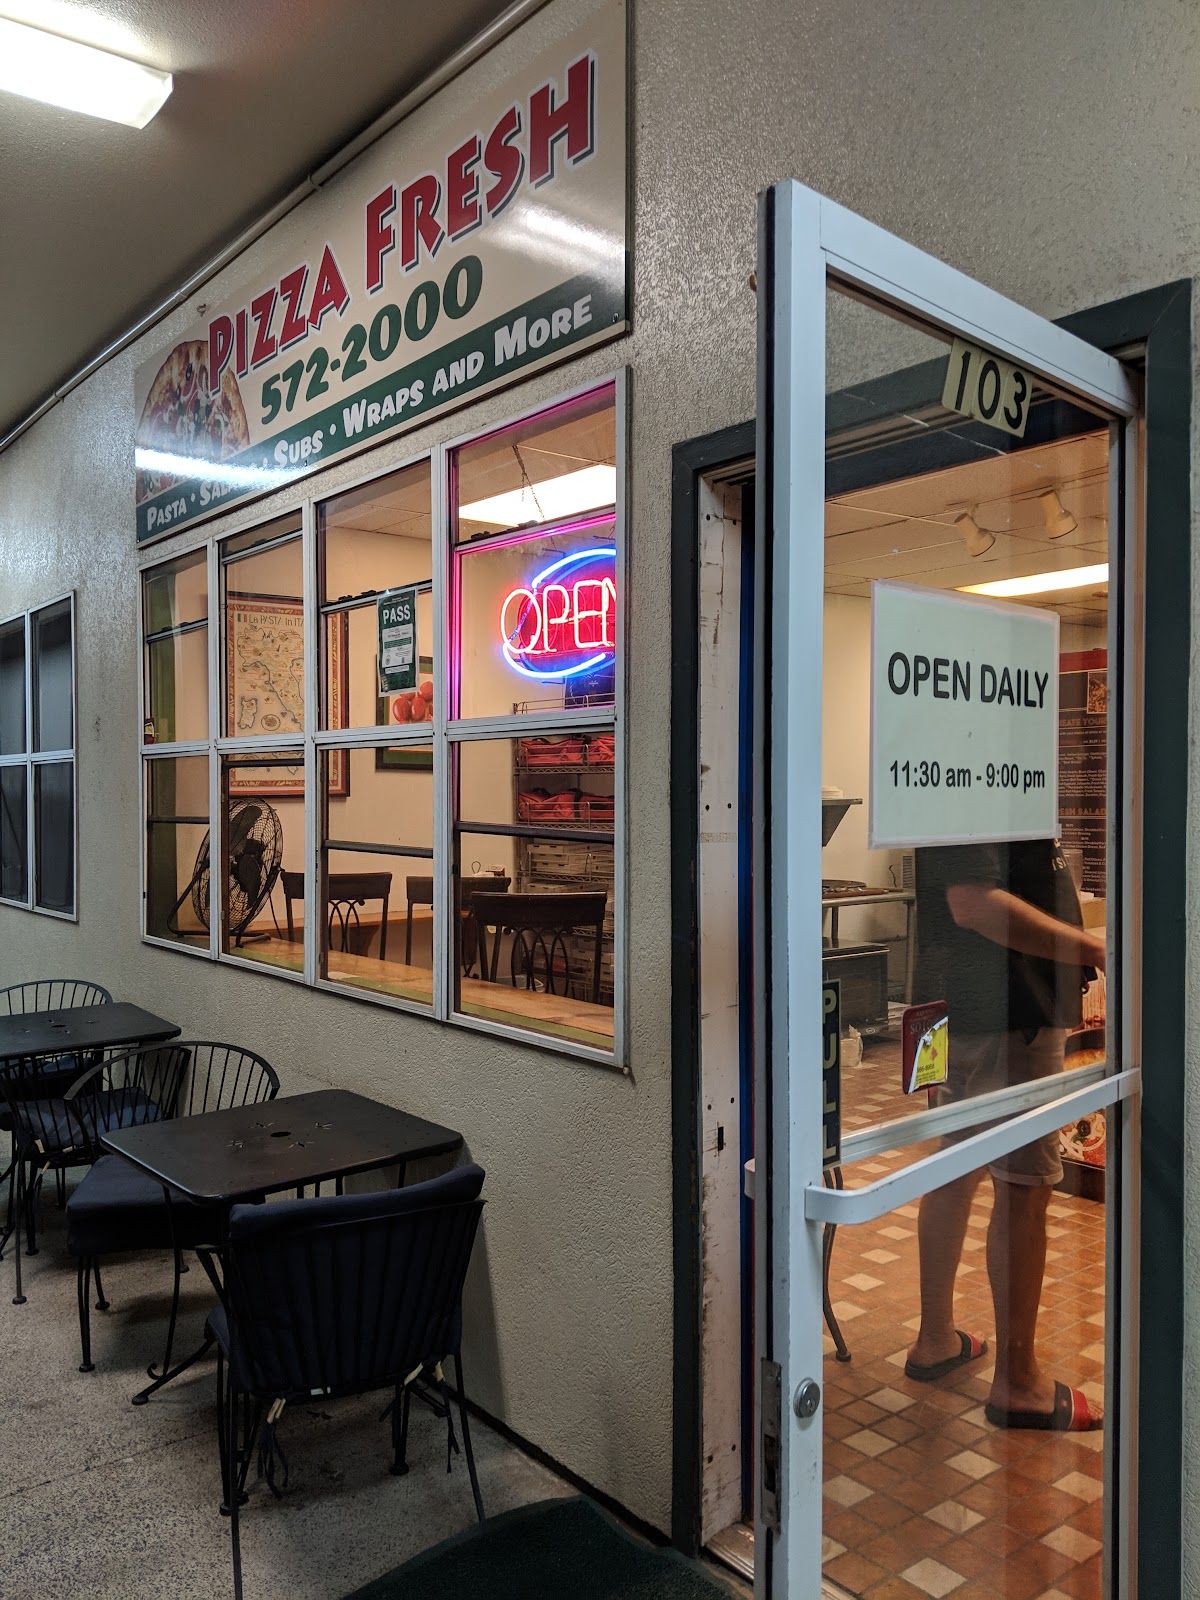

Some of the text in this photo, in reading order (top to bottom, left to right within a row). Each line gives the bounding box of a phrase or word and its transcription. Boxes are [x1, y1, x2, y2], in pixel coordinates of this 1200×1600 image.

[209, 54, 595, 396] PIZZA FRESH
[261, 255, 483, 425] 572-2000
[147, 498, 187, 531] PASTA
[274, 430, 324, 469] SUBS
[343, 379, 424, 438] WRAPS
[432, 351, 484, 396] AND
[494, 294, 593, 367] MORE
[954, 350, 1027, 430] 103
[383, 604, 411, 625] PASS
[888, 651, 1049, 709] OPEN DAILY
[890, 760, 941, 787] 11:30
[946, 767, 971, 788] am
[986, 763, 1019, 788] 9:00
[1024, 768, 1045, 793] pm
